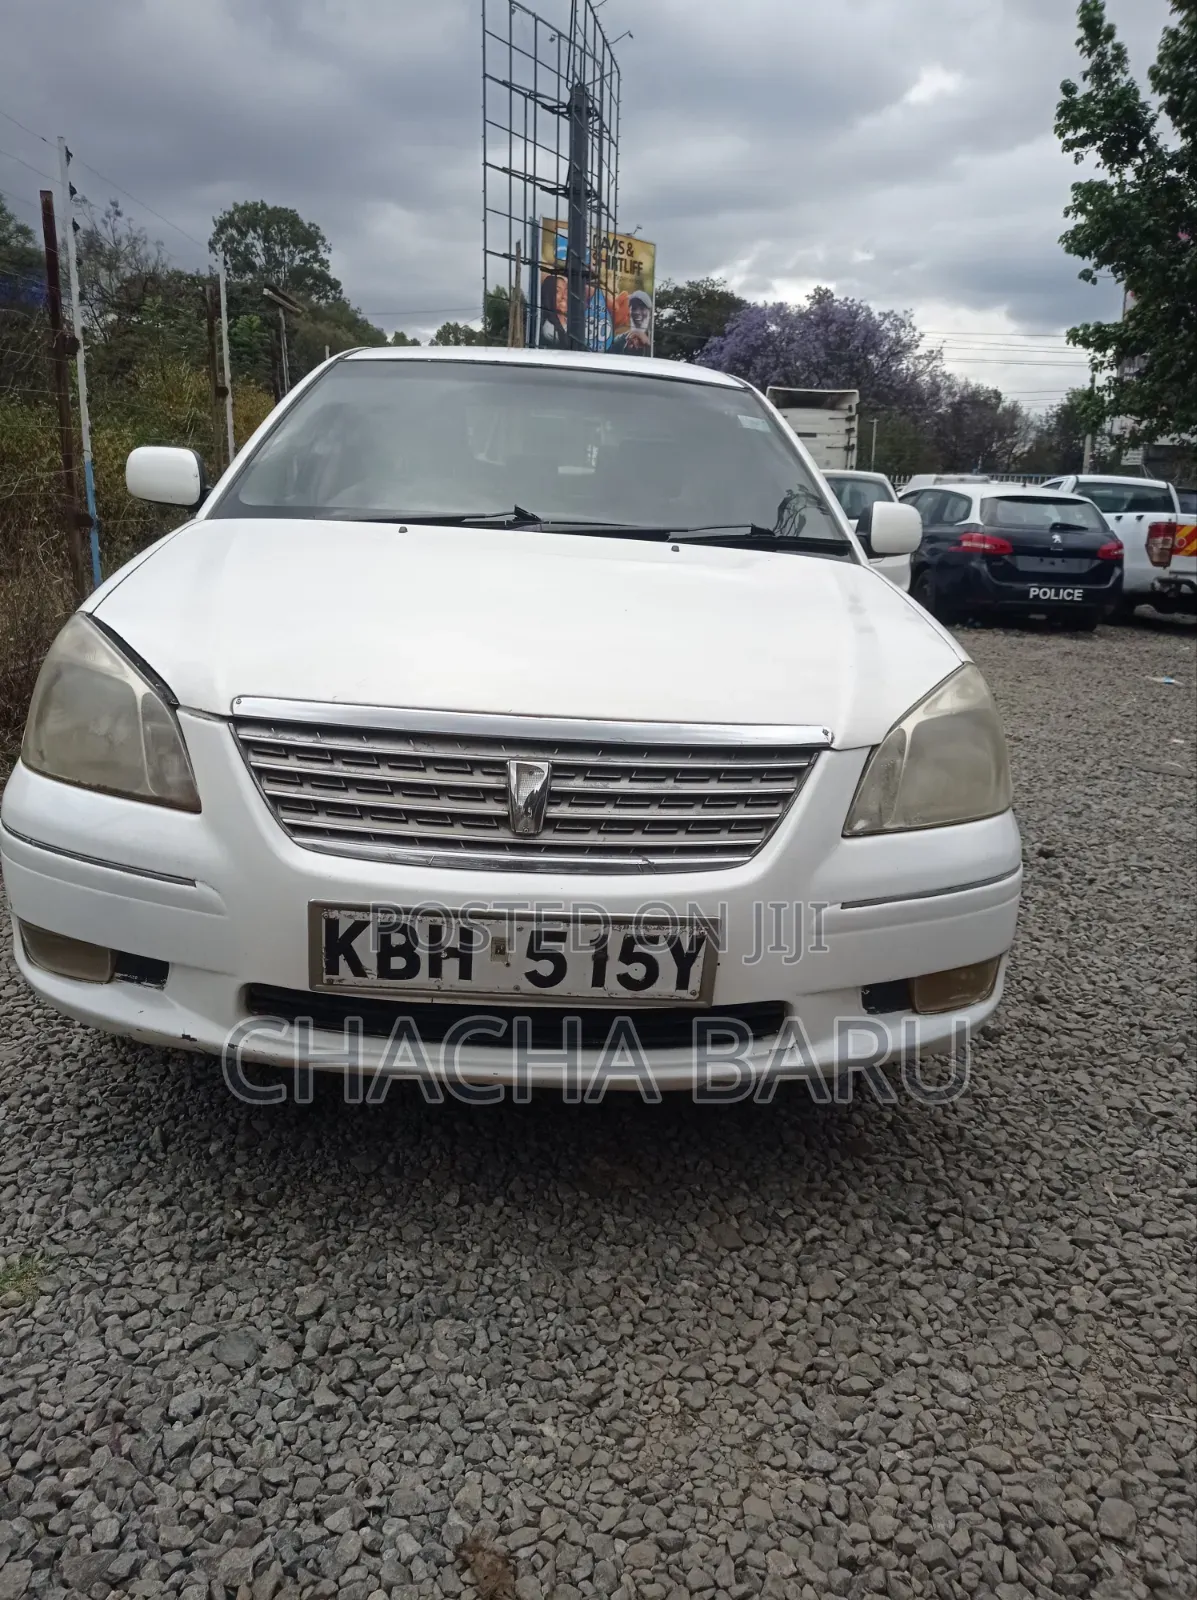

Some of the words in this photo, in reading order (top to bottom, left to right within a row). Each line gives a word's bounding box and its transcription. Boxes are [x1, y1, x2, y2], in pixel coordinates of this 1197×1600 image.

[1029, 587, 1084, 601] POLICE
[324, 918, 474, 980] KBH
[524, 930, 706, 992] 515Y
